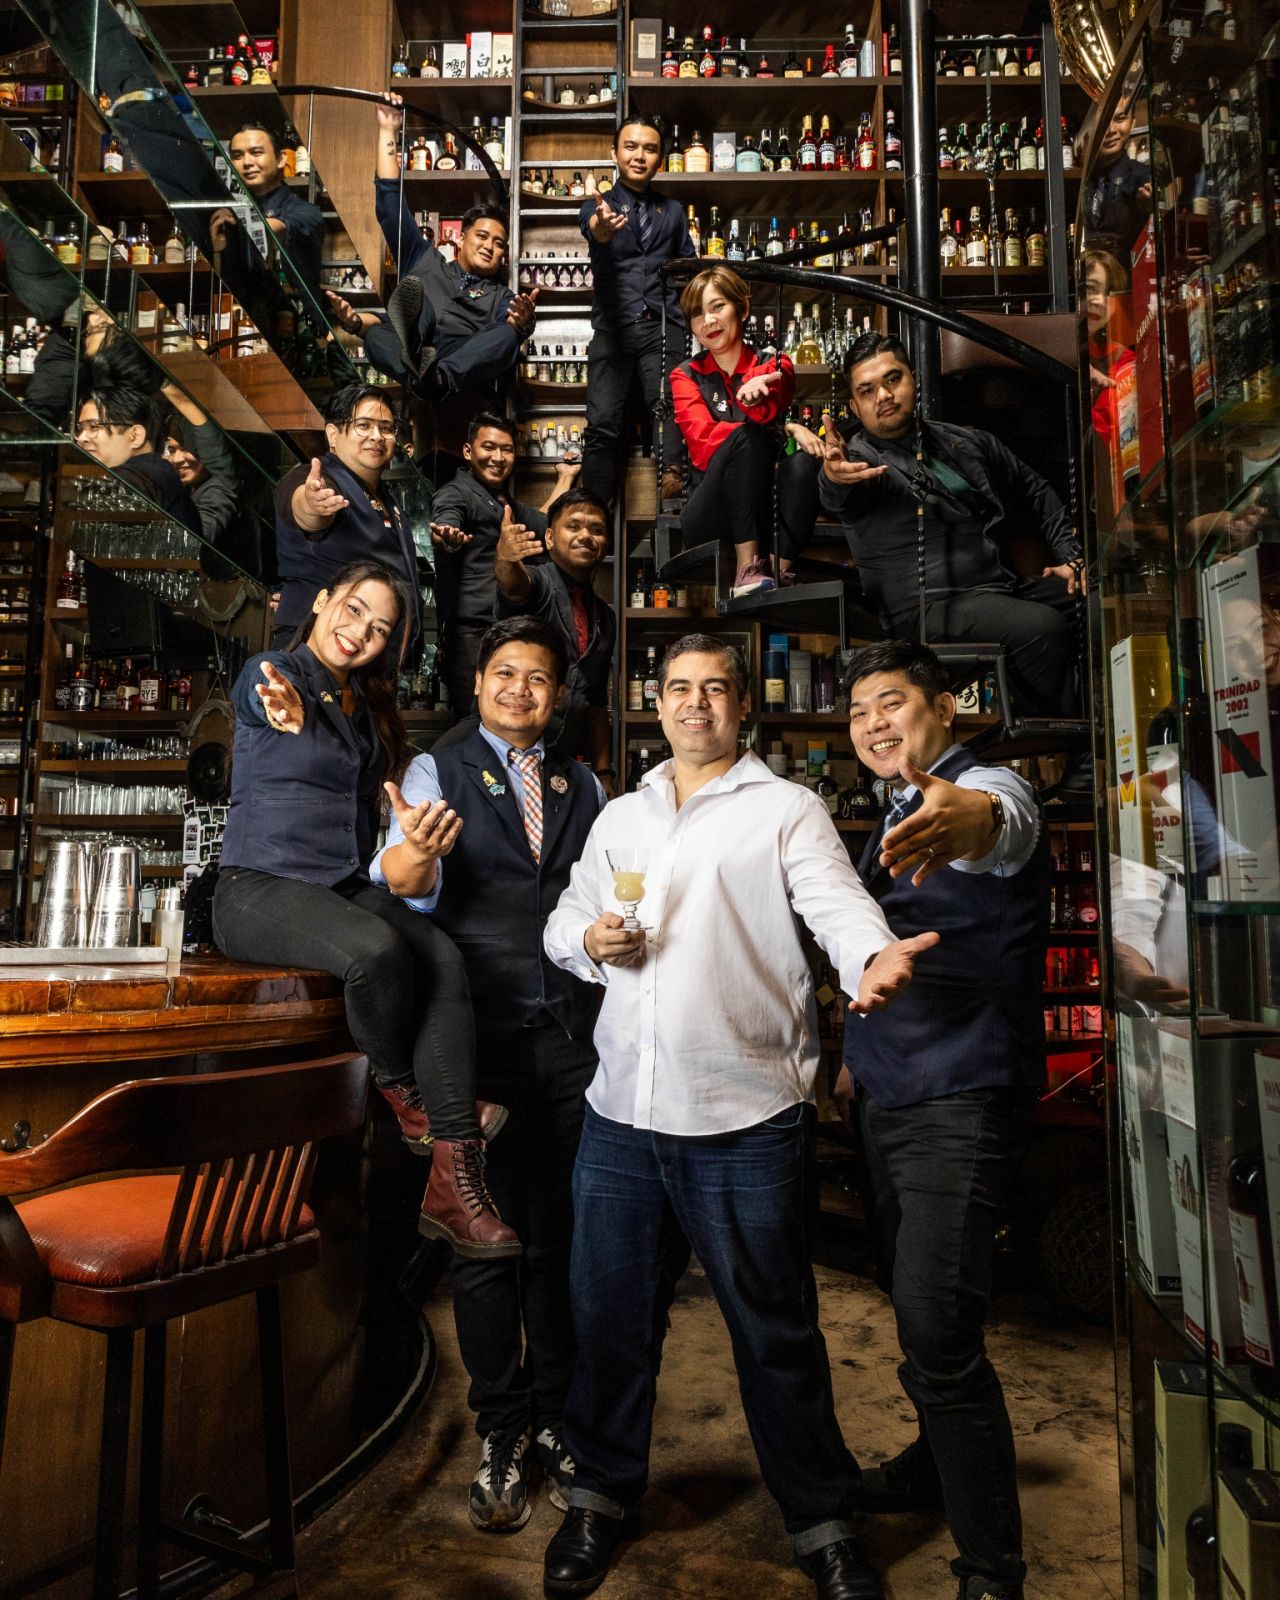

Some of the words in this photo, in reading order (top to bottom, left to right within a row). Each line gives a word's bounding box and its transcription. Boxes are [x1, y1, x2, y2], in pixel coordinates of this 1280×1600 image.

[141, 689, 157, 701] RYE
[1214, 679, 1261, 702] TRINIDAD
[1226, 697, 1249, 714] 2002
